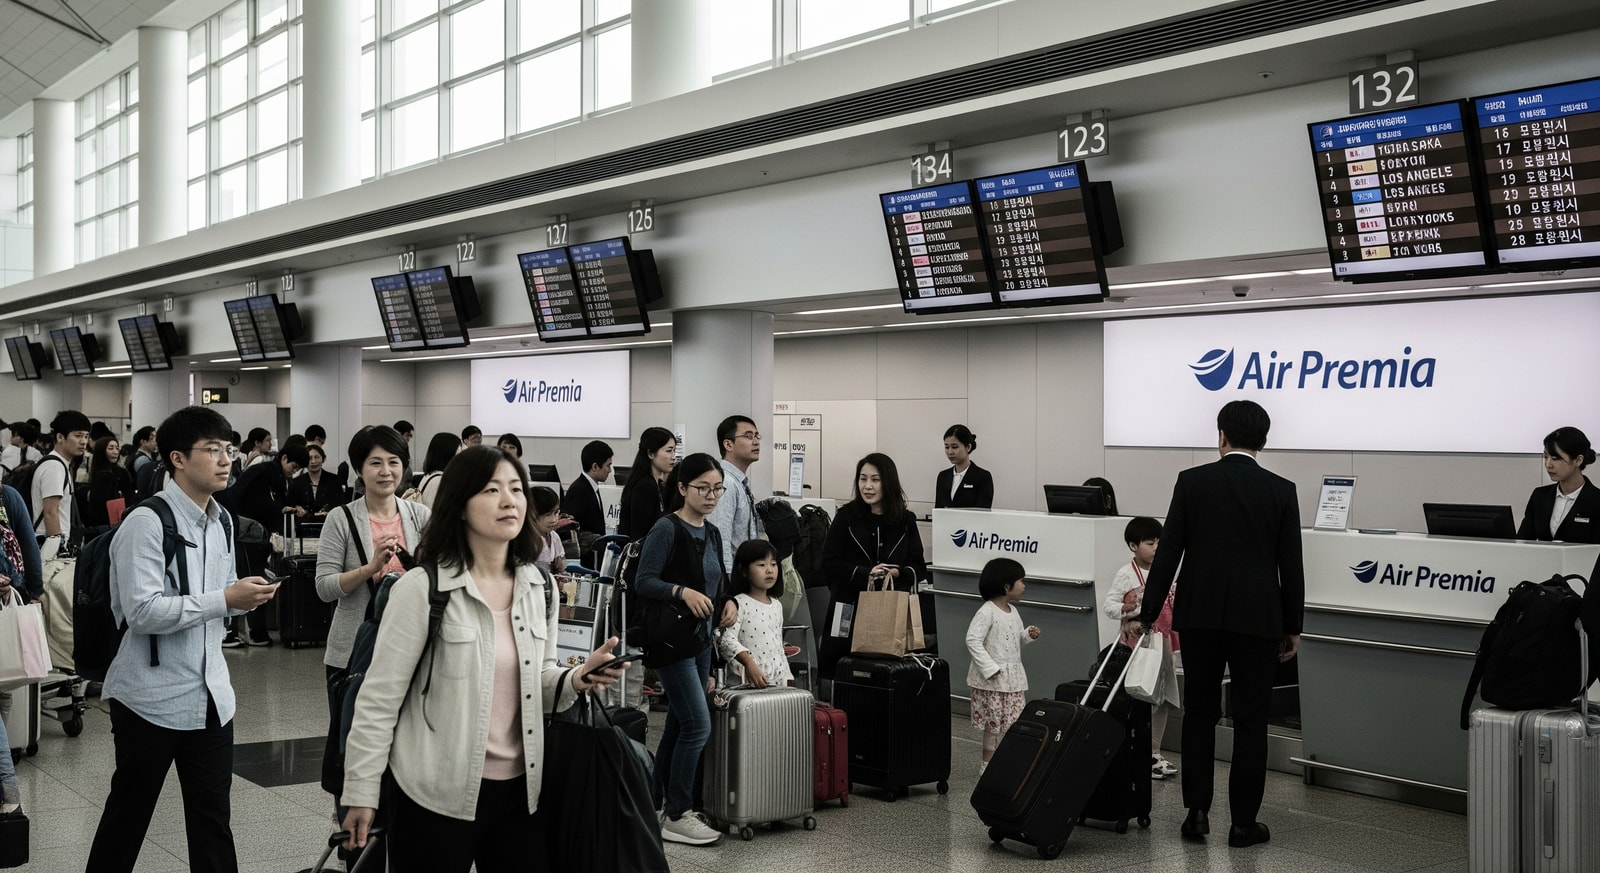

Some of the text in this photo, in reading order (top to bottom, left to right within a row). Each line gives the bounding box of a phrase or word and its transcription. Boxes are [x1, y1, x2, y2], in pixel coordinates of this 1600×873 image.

[1351, 66, 1416, 110] 132
[1058, 122, 1106, 158] 123
[1496, 142, 1511, 155] 17
[911, 152, 952, 185] 134
[1382, 172, 1404, 185] LOS
[1406, 166, 1453, 182] ANGELS
[1501, 173, 1516, 186] 19
[1505, 204, 1522, 216] 10
[1510, 234, 1526, 246] 28
[1237, 346, 1437, 390] Air Premia
[518, 378, 582, 403] Air Premia
[968, 532, 1039, 554] Air Premia
[1379, 563, 1496, 594] Air Premia
